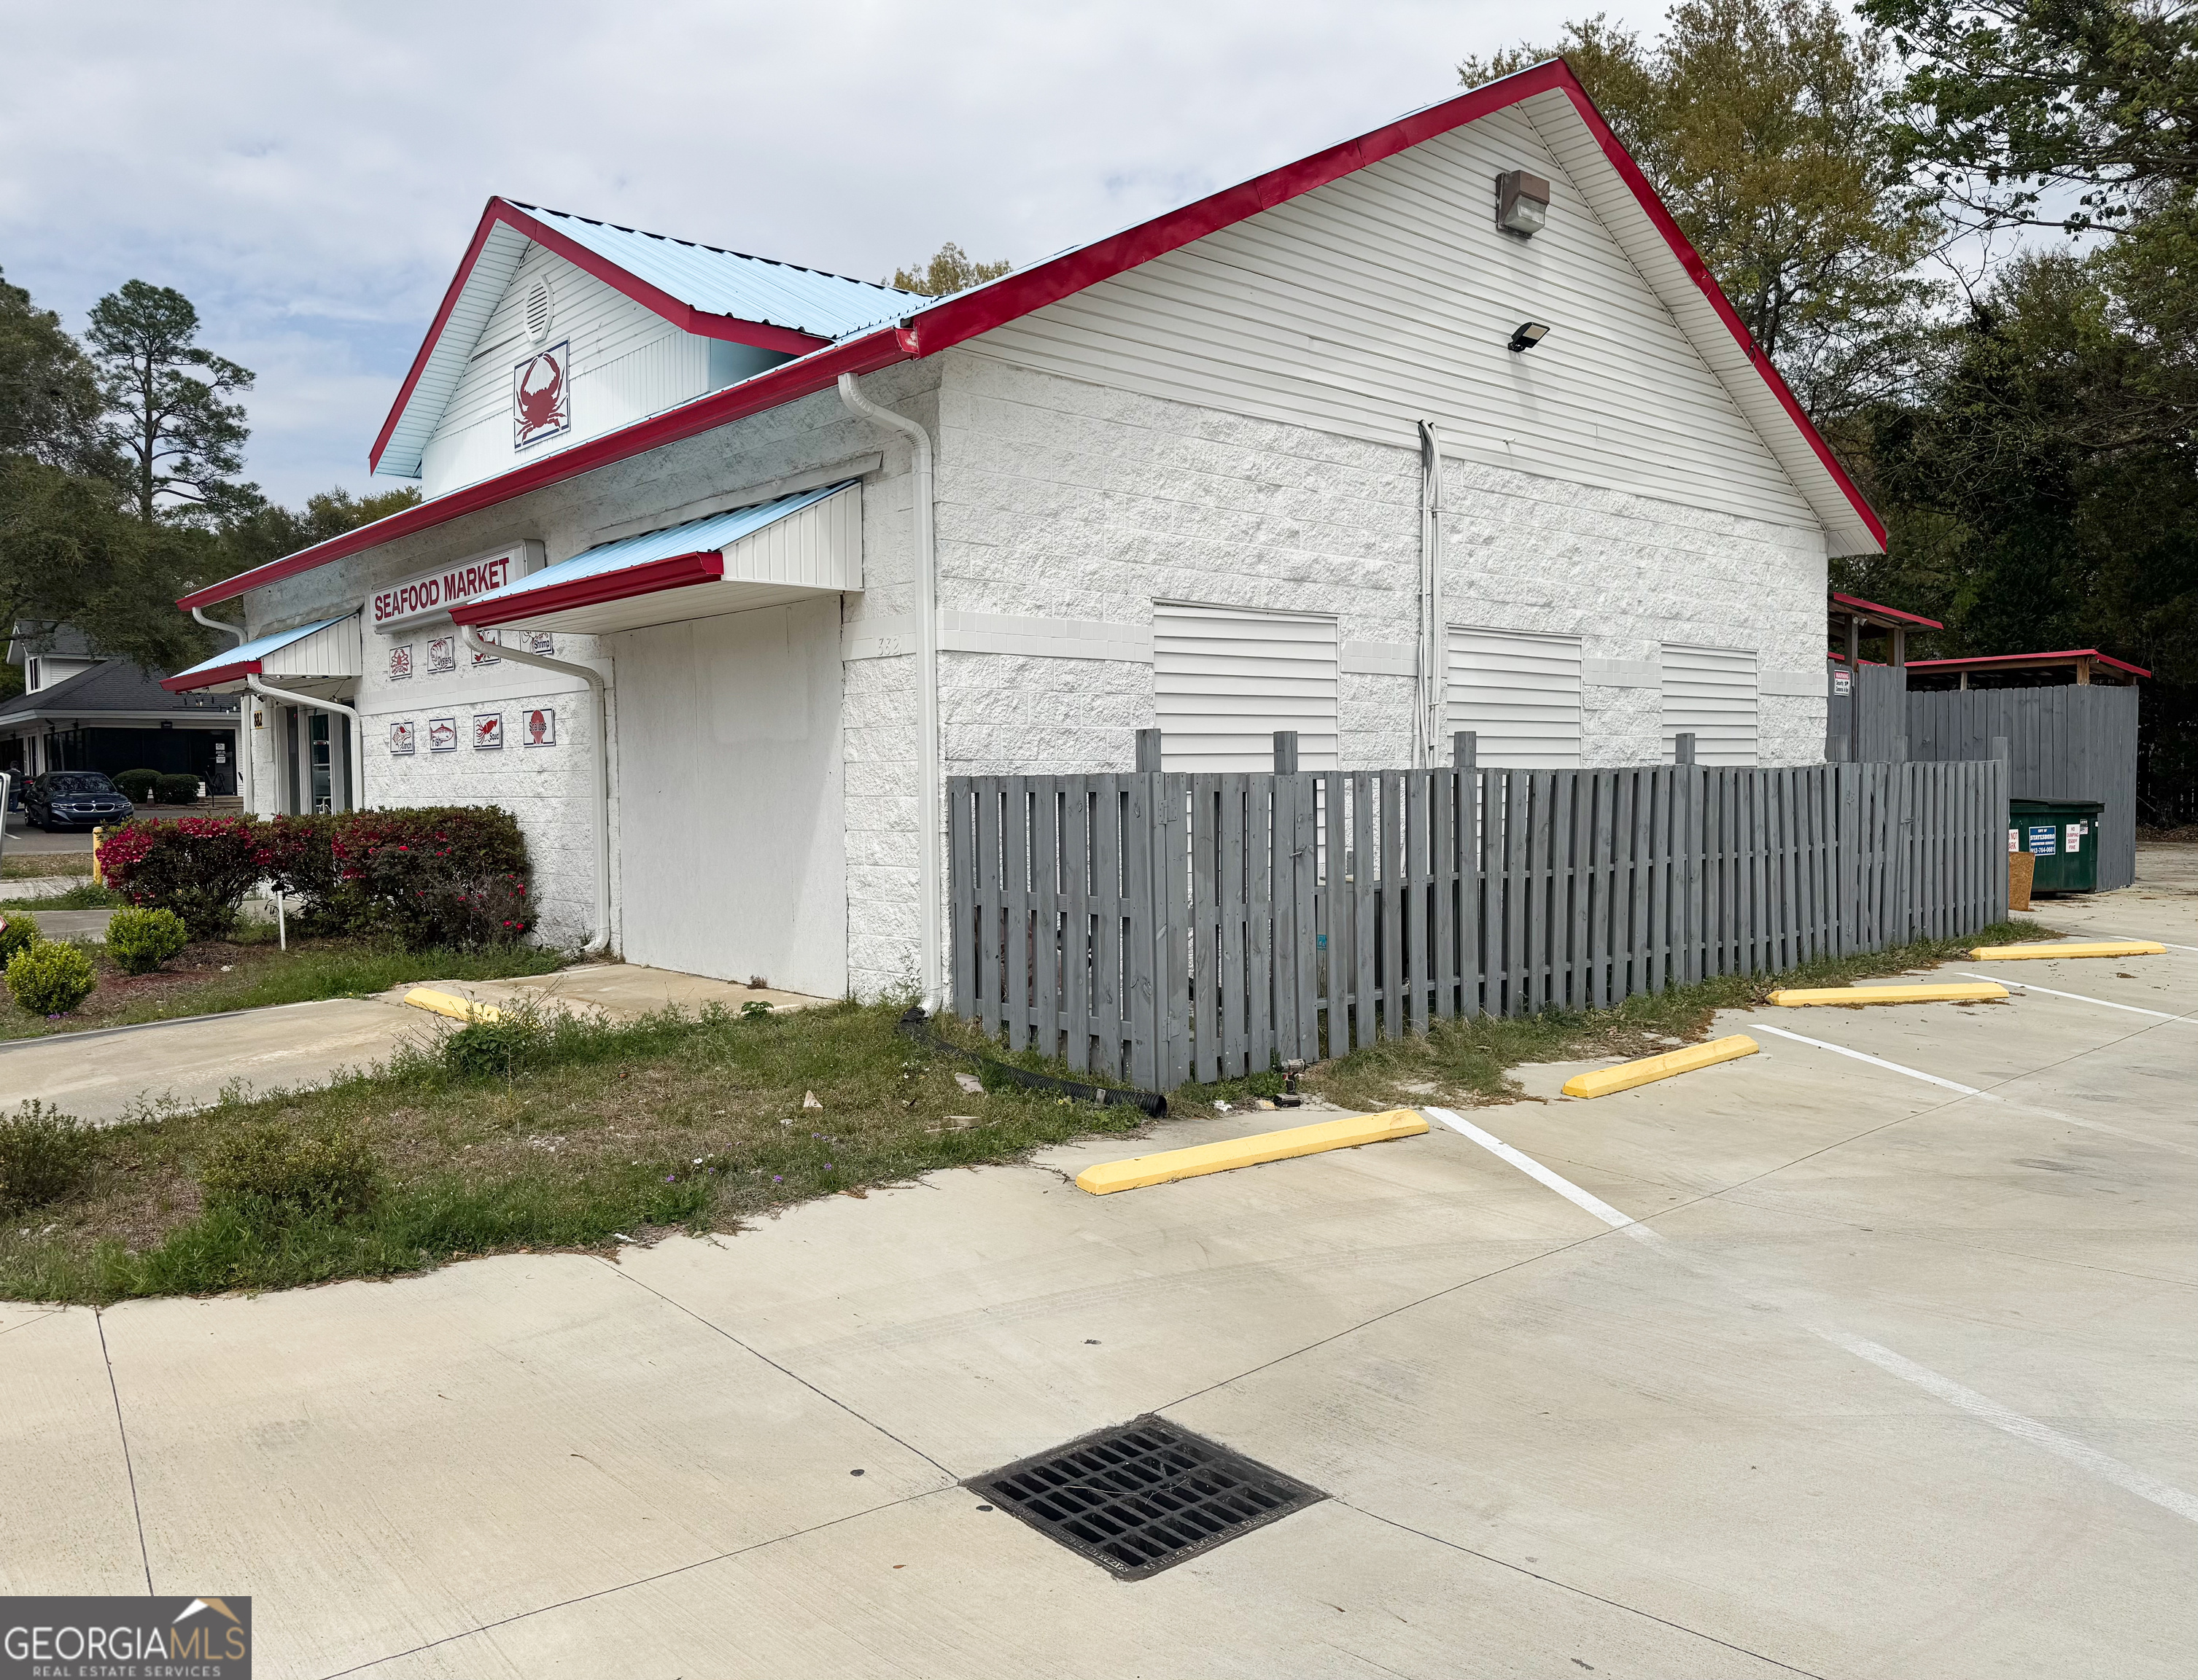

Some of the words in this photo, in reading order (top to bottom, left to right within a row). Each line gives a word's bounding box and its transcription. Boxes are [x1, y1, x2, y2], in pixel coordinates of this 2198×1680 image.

[375, 579, 440, 621] SEAFOOD
[443, 557, 510, 602] MARKET
[535, 639, 550, 649] Shrimp
[438, 656, 452, 666] Oysters
[254, 712, 263, 727] 882
[432, 736, 442, 747] Fish
[489, 732, 500, 741] Squid
